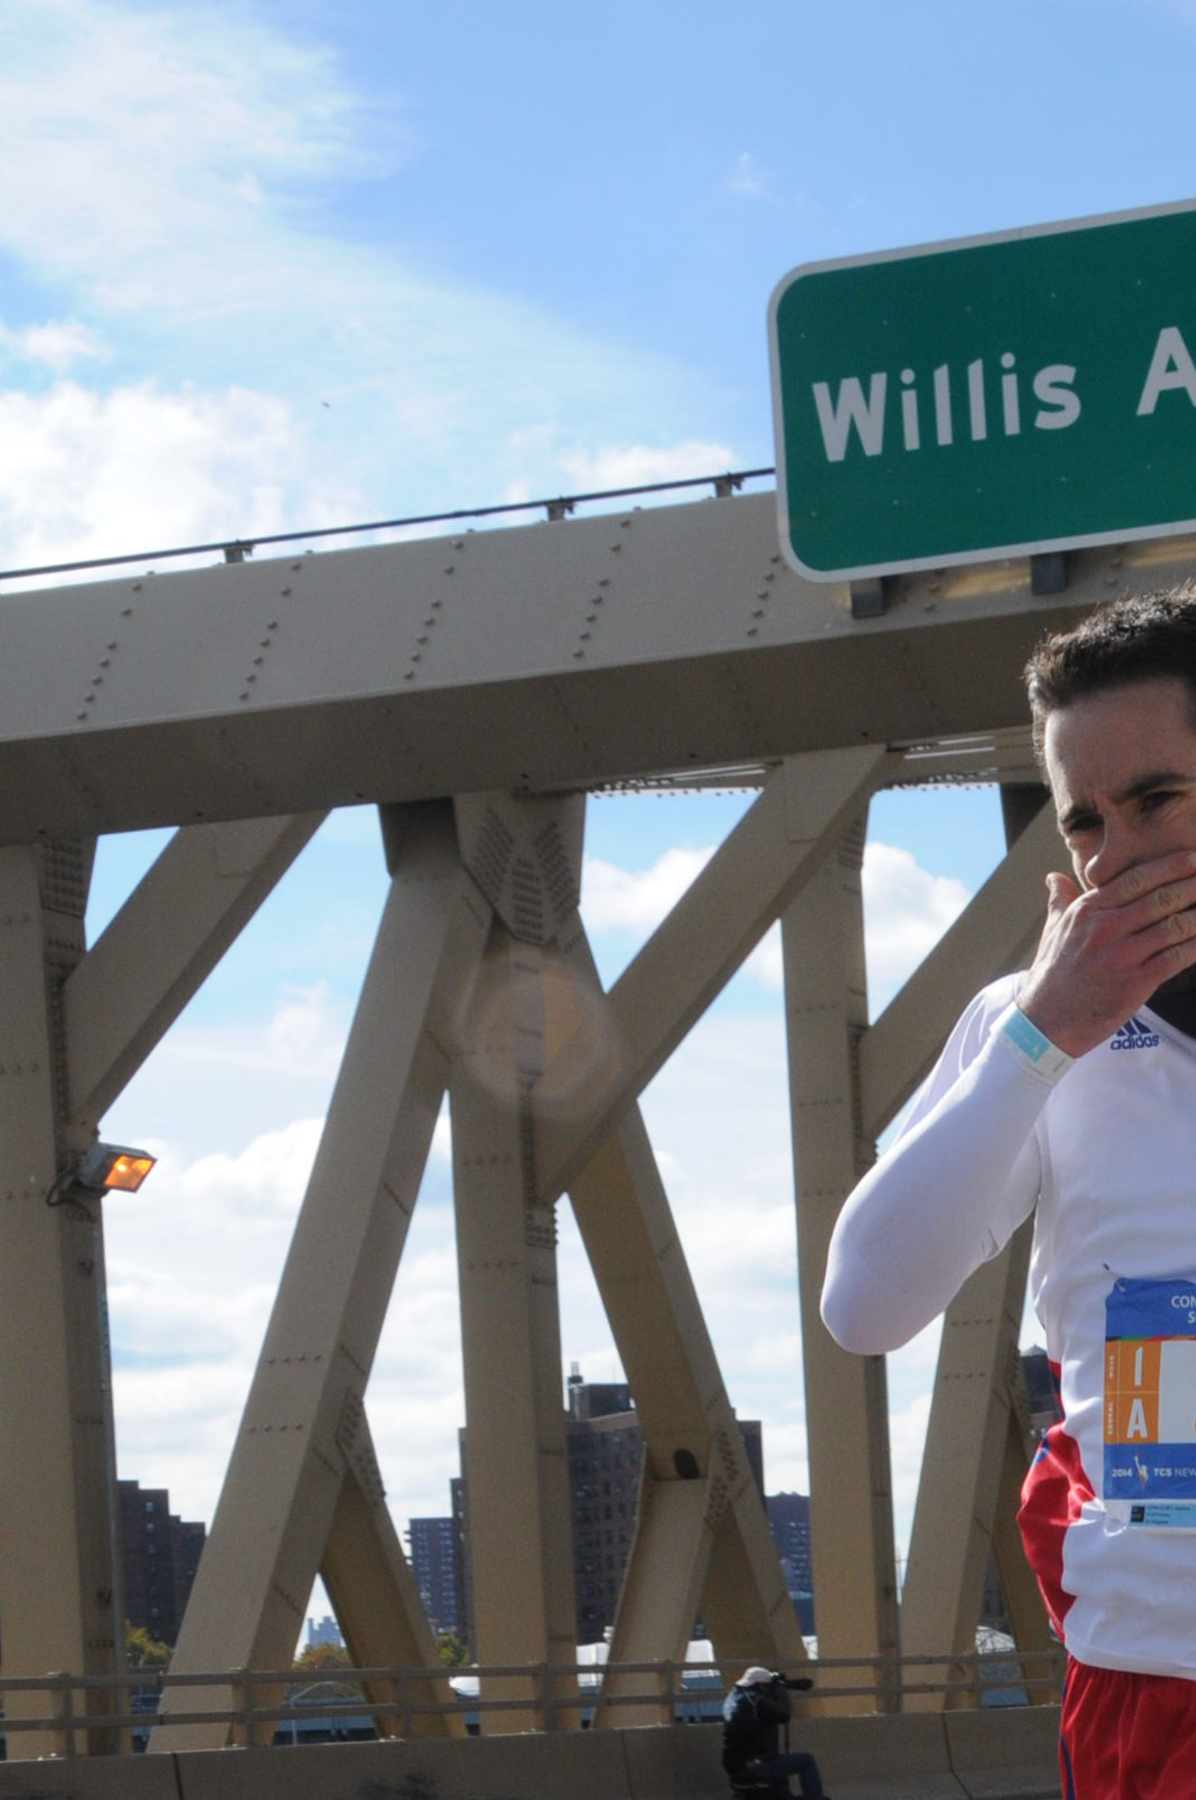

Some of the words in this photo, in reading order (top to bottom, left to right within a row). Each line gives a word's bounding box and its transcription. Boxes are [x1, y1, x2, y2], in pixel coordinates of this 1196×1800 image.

[813, 352, 1080, 461] Willis
[1110, 1033, 1160, 1051] adidas
[1126, 1398, 1148, 1438] A
[1111, 1468, 1133, 1478] 2014
[1154, 1468, 1173, 1477] TCS
